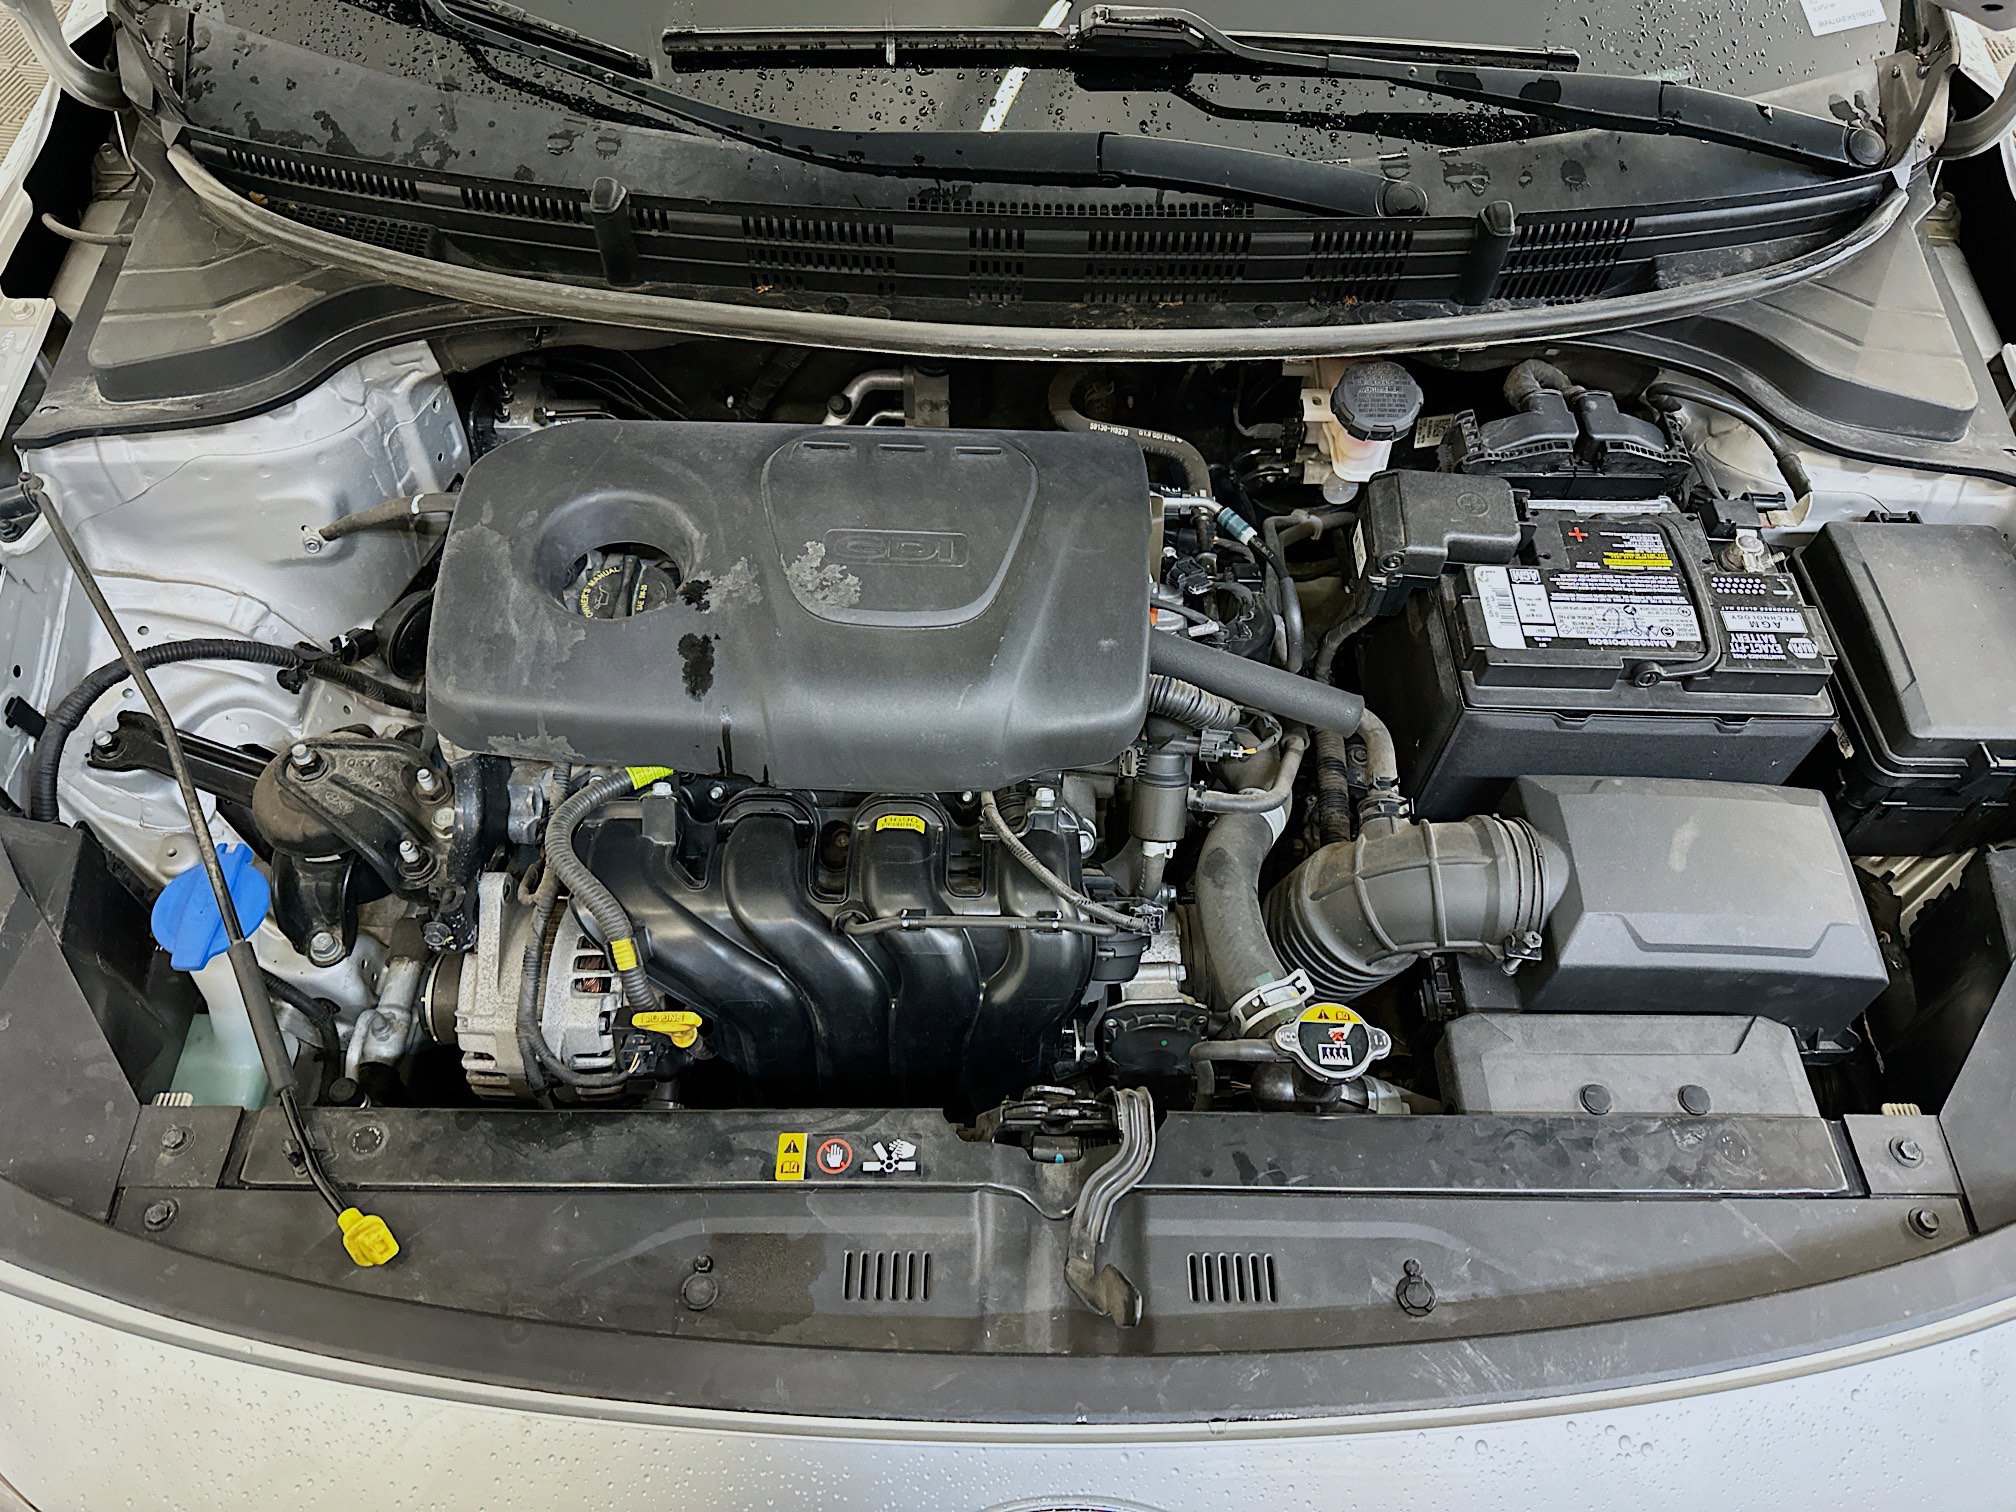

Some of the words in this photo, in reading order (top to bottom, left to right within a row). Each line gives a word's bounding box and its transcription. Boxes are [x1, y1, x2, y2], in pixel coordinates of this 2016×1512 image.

[833, 537, 954, 562] GDI
[1511, 570, 1538, 581] AGM
[580, 587, 594, 619] OWNER'S
[587, 566, 620, 588] MANUAL
[1749, 620, 1782, 629] AGM
[1588, 638, 1668, 647] DANGER/POISON
[1730, 633, 1778, 643] BATTERY
[1730, 642, 1784, 653] EXACT-FIT
[1790, 642, 1814, 654] NAPA
[661, 1013, 685, 1023] ENG
[1279, 1032, 1297, 1042] HCC
[1373, 1034, 1387, 1045] 1.1
